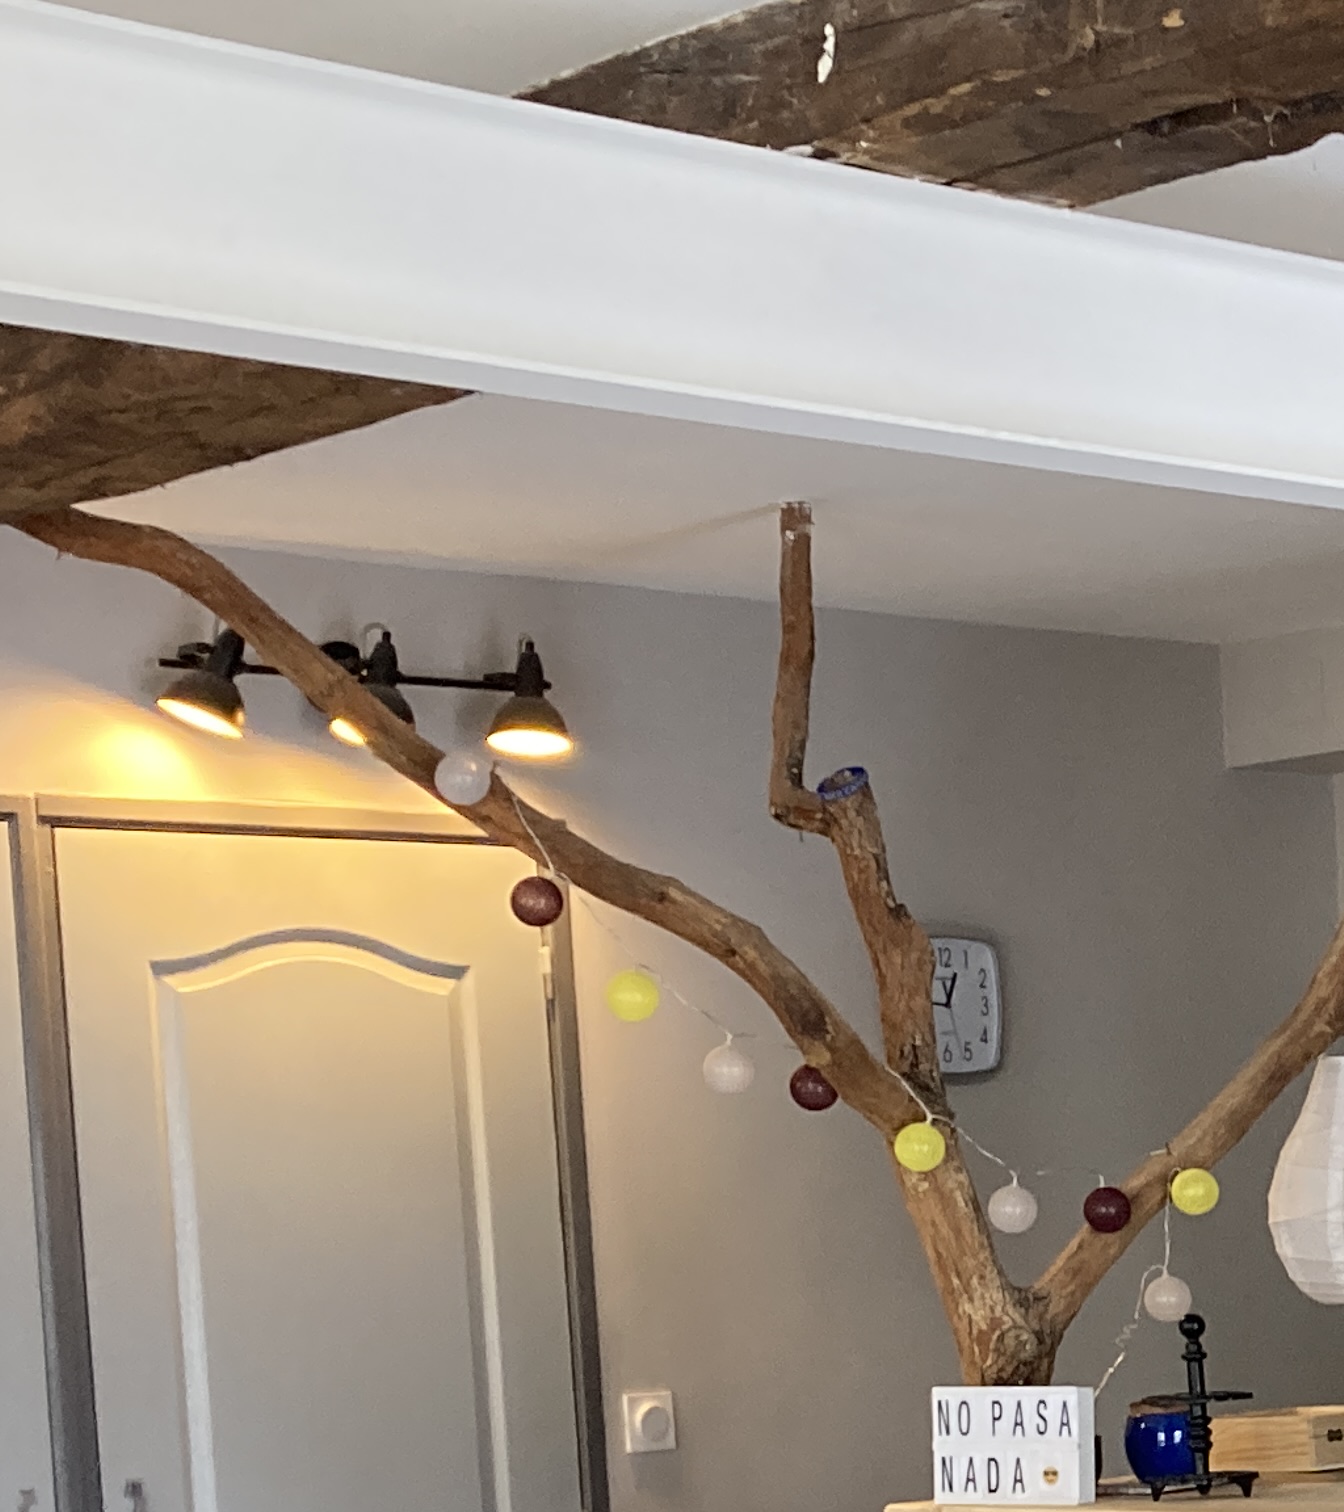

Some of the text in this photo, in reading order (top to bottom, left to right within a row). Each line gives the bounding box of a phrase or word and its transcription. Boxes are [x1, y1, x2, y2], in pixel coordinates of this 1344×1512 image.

[938, 947, 952, 968] 12
[978, 967, 987, 989] 2
[981, 996, 989, 1017] 3
[980, 1026, 988, 1044] 4
[943, 1041, 973, 1063] 6 5
[937, 1399, 1072, 1438] NO PASA
[941, 1456, 1026, 1494] NADA
